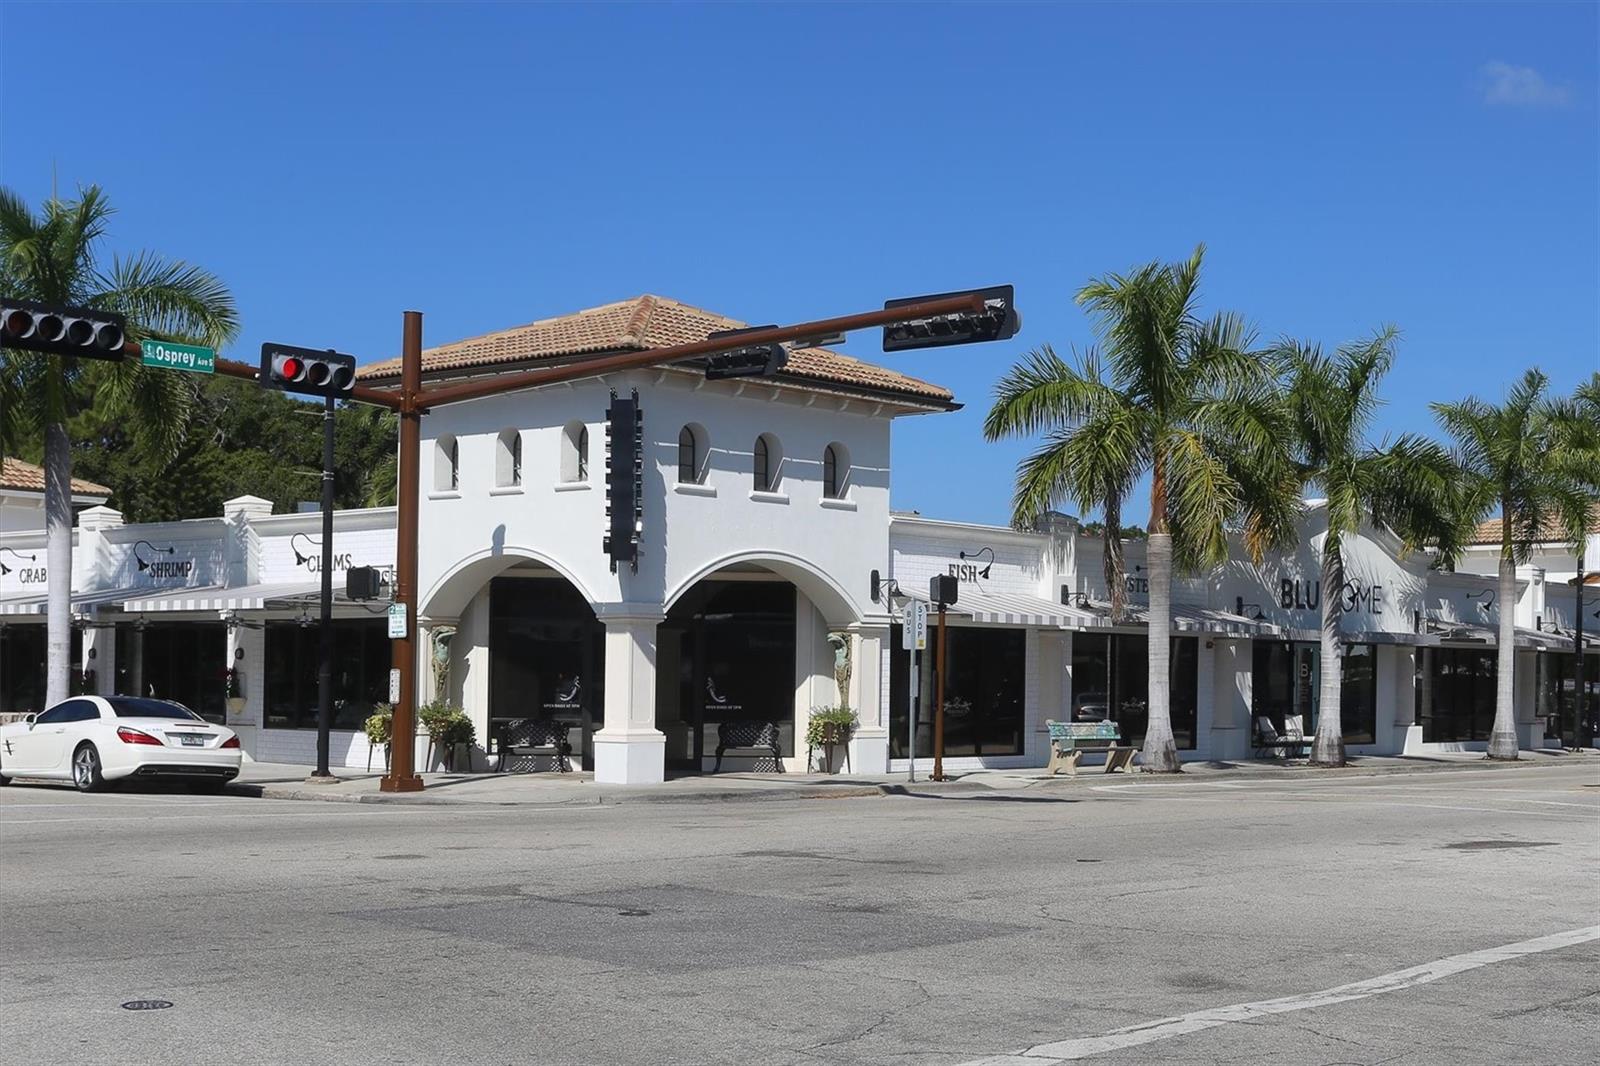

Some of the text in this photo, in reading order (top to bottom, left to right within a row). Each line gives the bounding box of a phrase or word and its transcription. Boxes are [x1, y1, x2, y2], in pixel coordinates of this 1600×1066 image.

[156, 345, 195, 367] Osprey
[197, 357, 208, 366] Ave
[209, 358, 214, 367] S
[149, 561, 192, 578] SHRIMP
[307, 553, 352, 572] CLMS
[19, 567, 47, 583] CRAB
[948, 563, 977, 583] FISH
